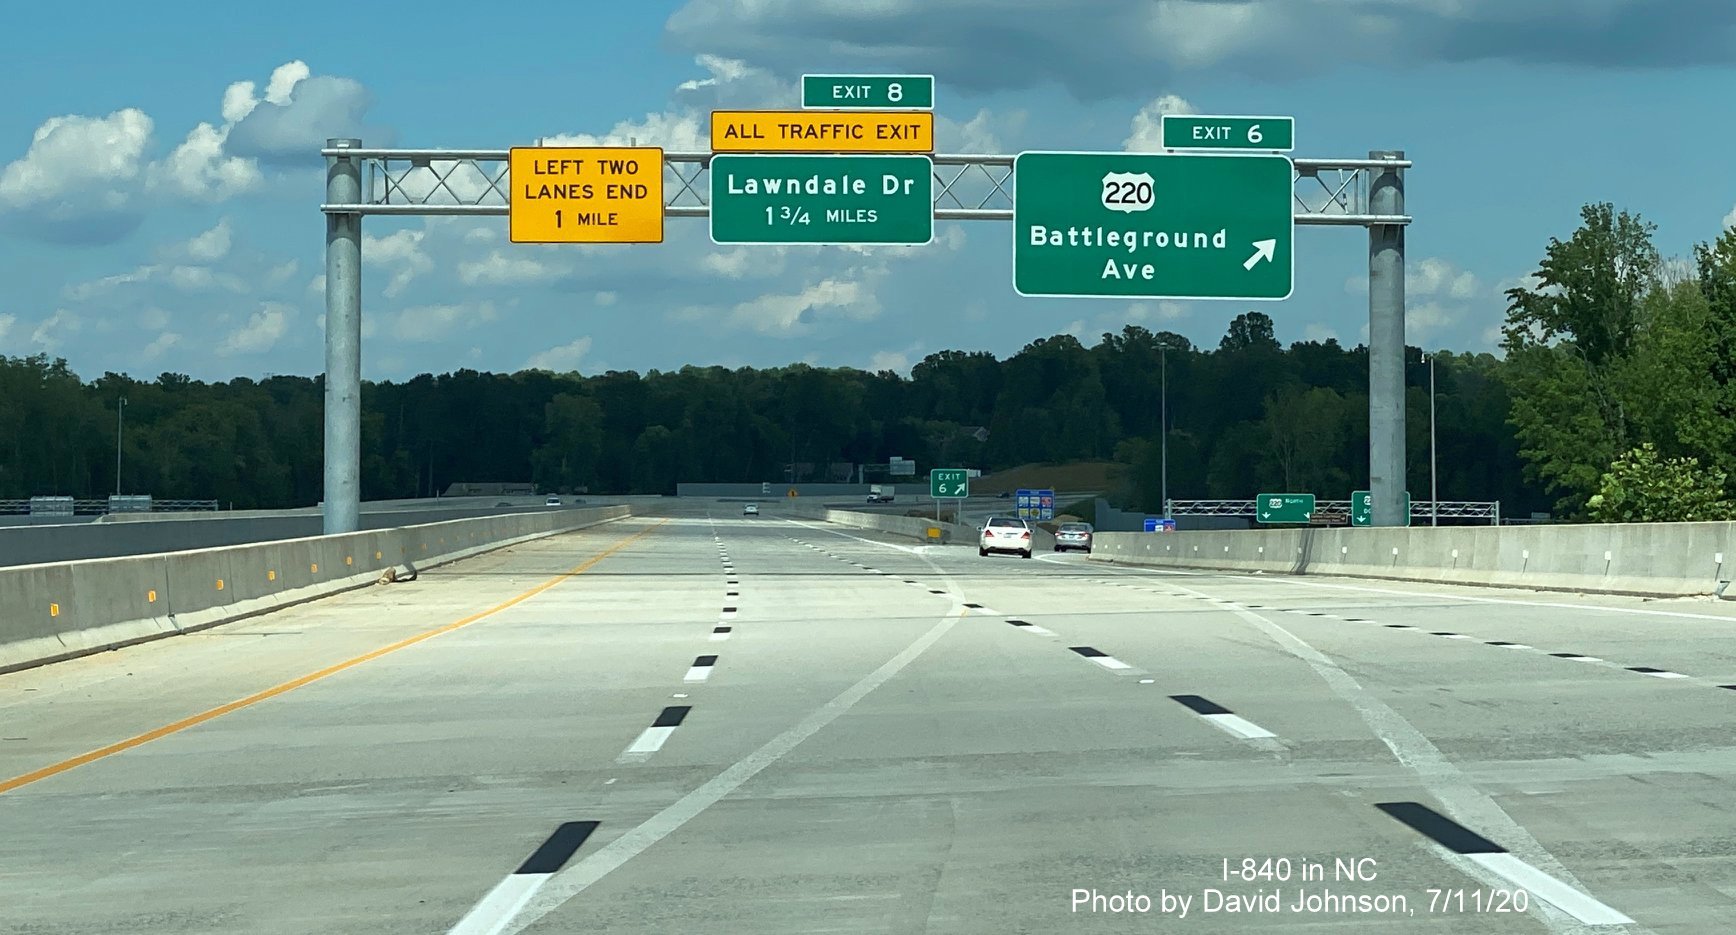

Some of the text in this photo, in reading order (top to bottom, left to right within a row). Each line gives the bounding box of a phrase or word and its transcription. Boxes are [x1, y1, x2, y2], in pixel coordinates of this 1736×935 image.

[832, 83, 904, 102] EXIT 8
[724, 124, 921, 139] ALL TRAFFIC EXIT
[1192, 124, 1263, 143] EXIT 6
[534, 160, 639, 175] LEFT TWO
[525, 184, 648, 199] LANES END
[728, 174, 915, 195] Lawndale Dr
[1105, 181, 1152, 204] 220
[555, 210, 618, 228] 1 MILE
[826, 209, 878, 223] MILES
[1030, 226, 1227, 253] Battleground
[1101, 259, 1155, 280] Ave
[938, 473, 961, 481] EXIT
[939, 483, 947, 494] 6
